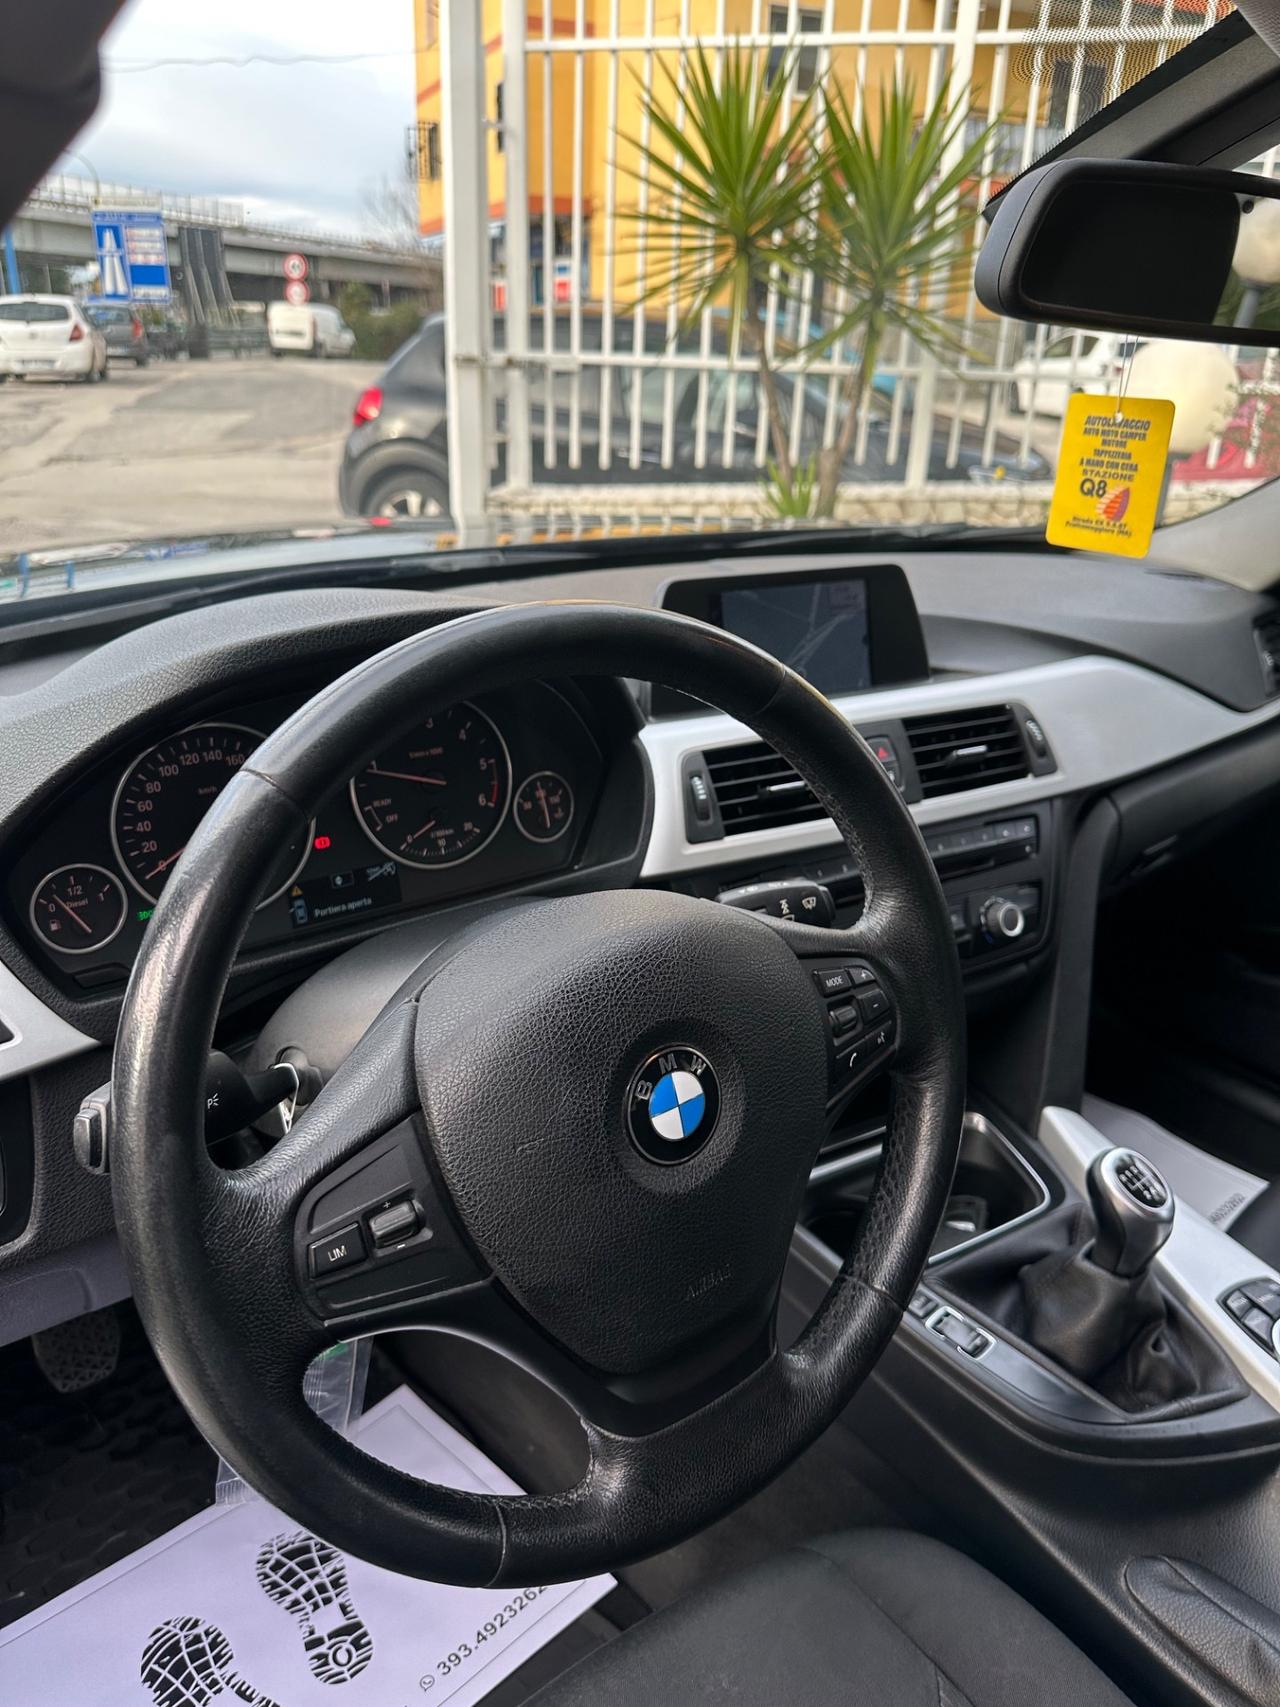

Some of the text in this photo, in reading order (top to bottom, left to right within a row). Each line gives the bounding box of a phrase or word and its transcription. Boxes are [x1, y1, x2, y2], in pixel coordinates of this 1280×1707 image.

[1085, 415, 1151, 432] AUTOLAVAGGIO
[1083, 427, 1147, 441] AUTO MOTO CAMPER
[1082, 469, 1134, 482] STAZIONE
[1079, 478, 1108, 498] Q8
[424, 717, 434, 729] 3
[457, 728, 467, 741] 4
[179, 753, 200, 766] 120
[203, 750, 223, 762] 140
[225, 753, 246, 767] 160
[158, 764, 180, 777] 100
[479, 757, 488, 771] 5
[145, 781, 162, 794] 80
[137, 799, 153, 812] 60
[477, 793, 487, 807] 6
[136, 820, 152, 832] 40
[141, 840, 158, 853] 20
[67, 885, 84, 897] 1/2
[48, 902, 56, 912] 0
[314, 896, 373, 918] Portiera aperta
[825, 975, 844, 988] MODE
[635, 1052, 707, 1101] BMW
[327, 1245, 348, 1262] LIM
